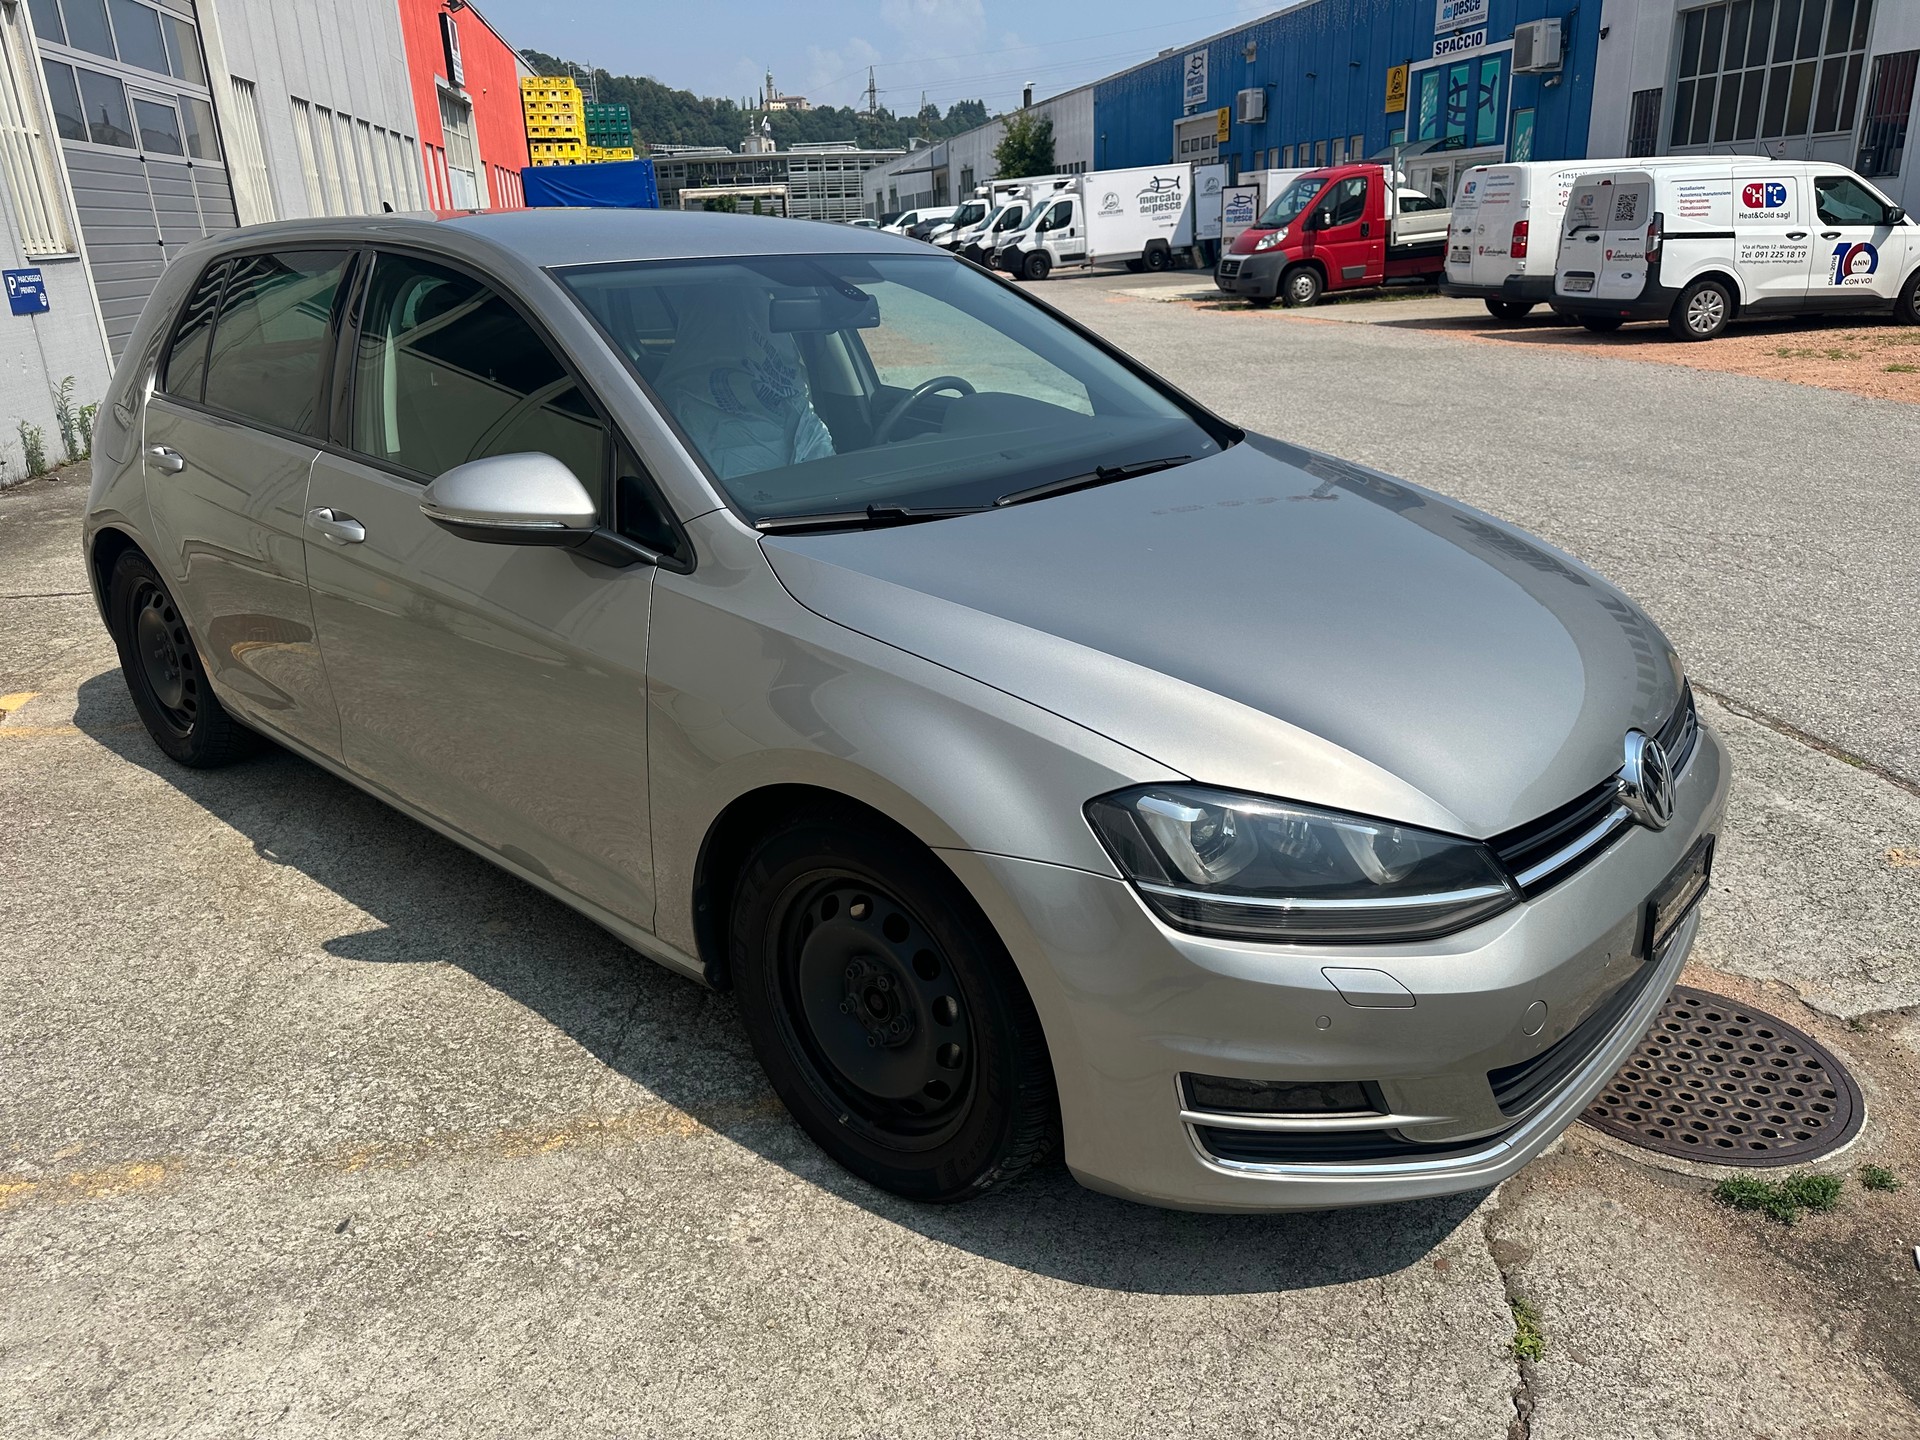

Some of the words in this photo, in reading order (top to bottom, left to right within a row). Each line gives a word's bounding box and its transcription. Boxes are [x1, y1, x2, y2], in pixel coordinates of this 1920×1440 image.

[1443, 4, 1453, 20] del
[1453, 0, 1481, 20] pesce
[1435, 31, 1483, 56] SPACCIO
[1139, 191, 1182, 205] mercato
[1140, 204, 1151, 214] del
[1152, 201, 1182, 214] pesce
[1225, 207, 1253, 216] mercato
[1233, 214, 1253, 224] pesce
[1738, 211, 1775, 220] Heat&Cold
[1776, 211, 1791, 220] sagl
[1754, 251, 1768, 259] 091
[1770, 251, 1784, 259] 225
[1853, 259, 1870, 267] ANNI
[8, 276, 16, 295] P
[1845, 278, 1860, 286] CON
